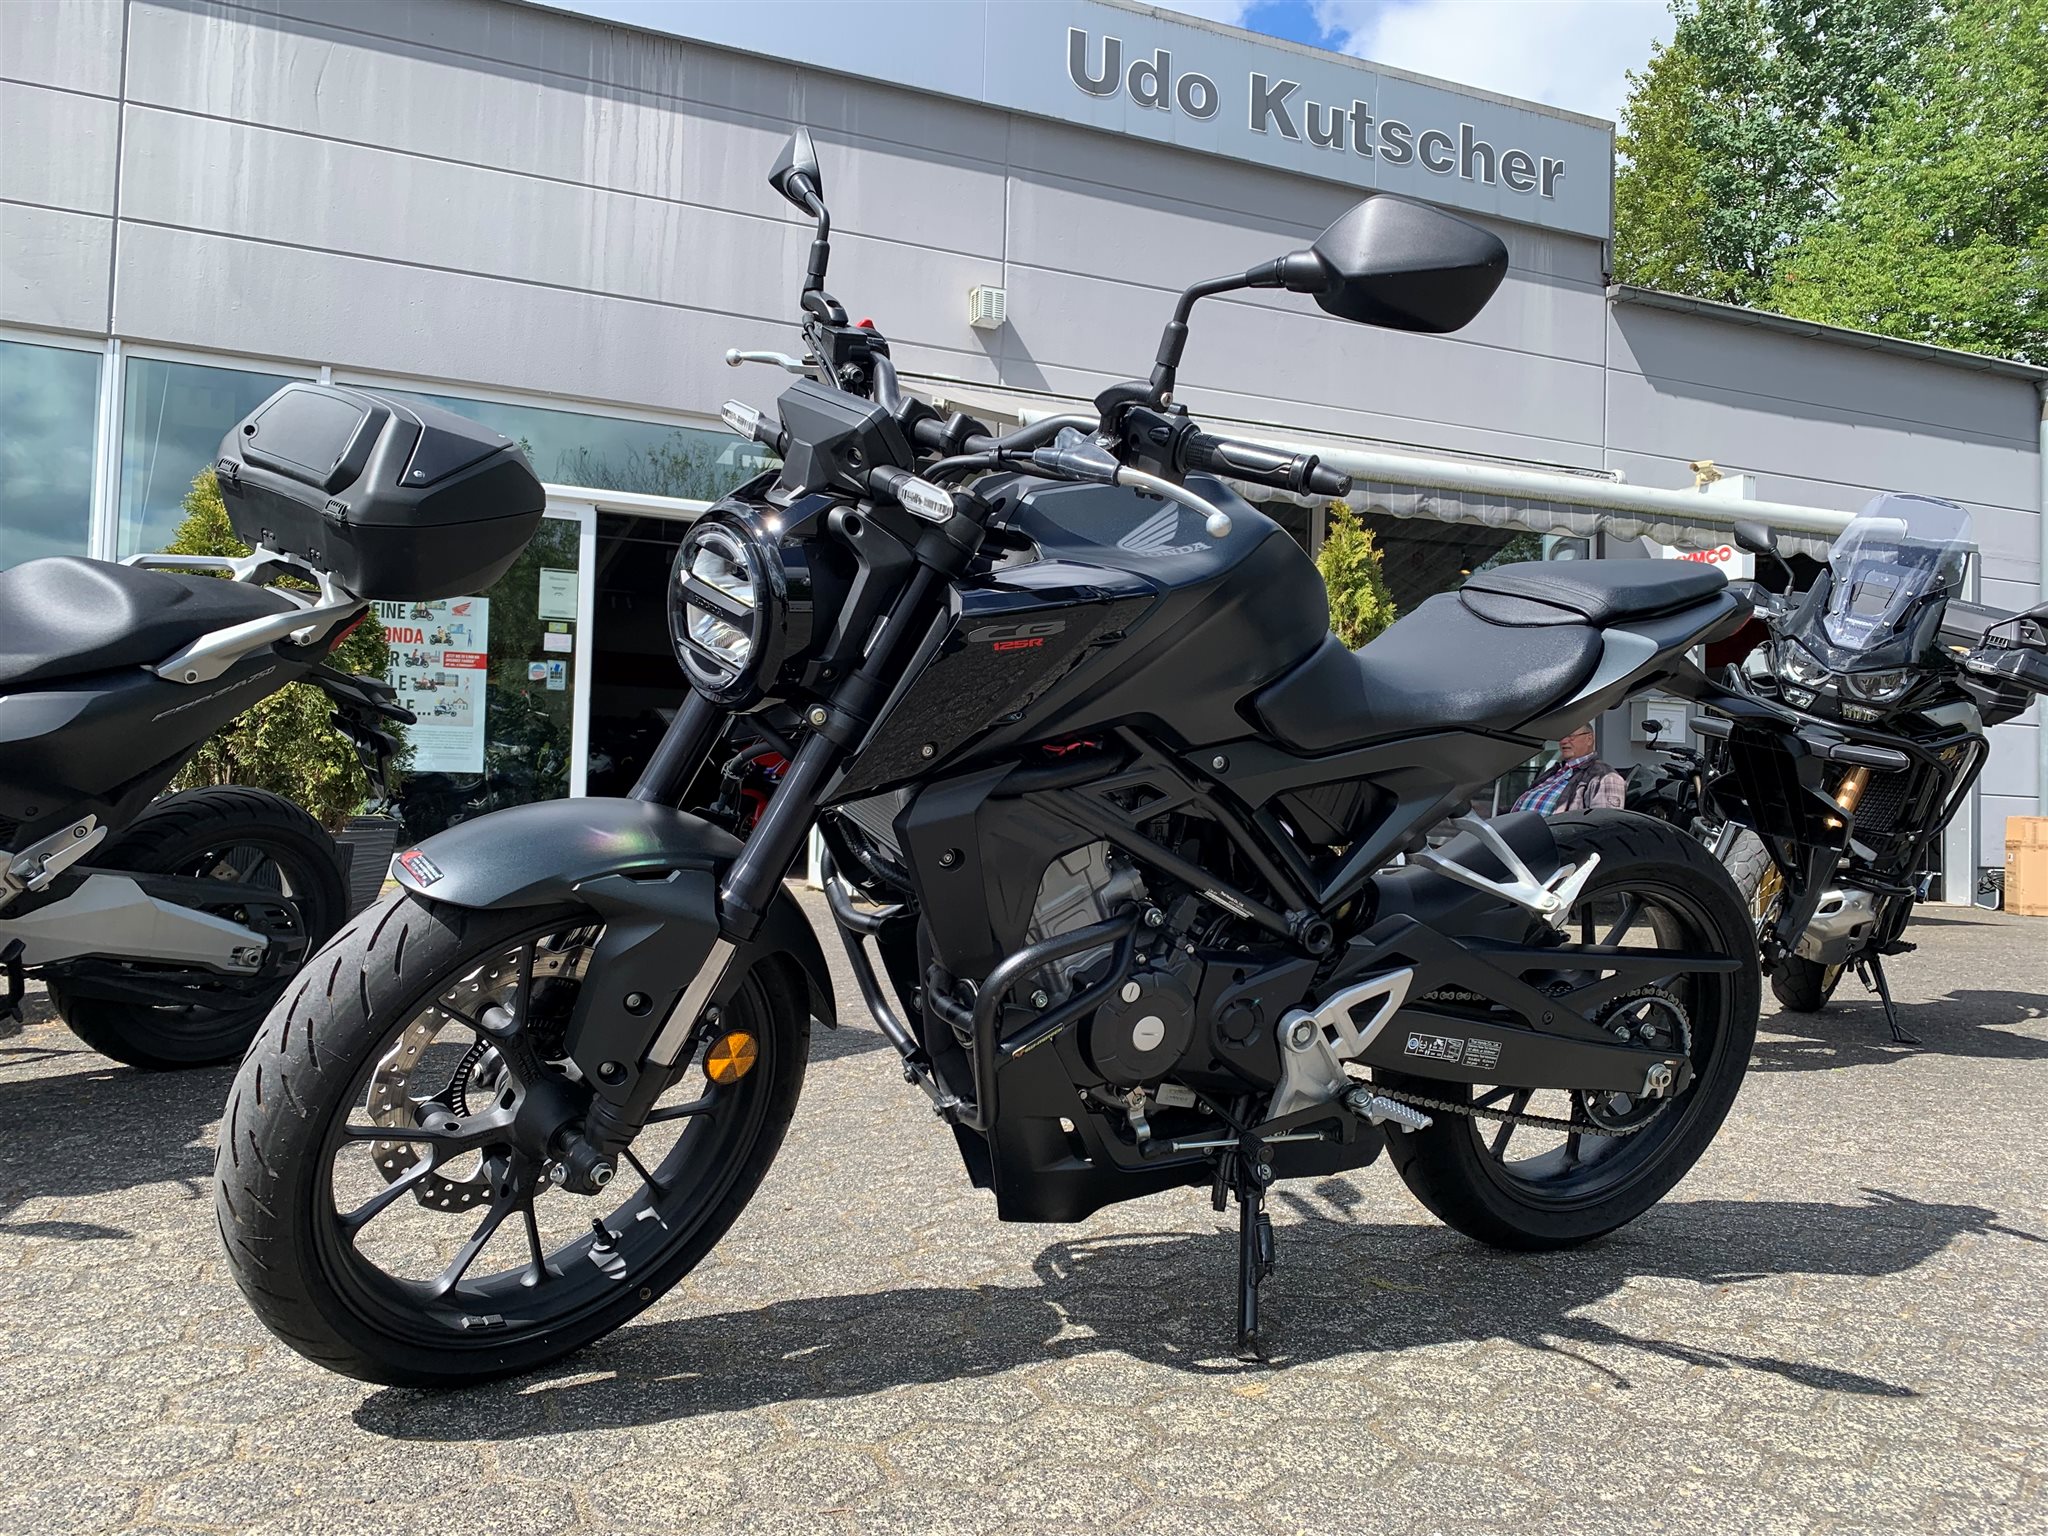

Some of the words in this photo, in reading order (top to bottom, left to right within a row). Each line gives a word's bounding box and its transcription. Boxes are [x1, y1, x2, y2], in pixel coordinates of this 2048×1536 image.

[1067, 26, 1220, 119] Udo
[1249, 71, 1565, 198] Kutscher
[968, 620, 1066, 642] CB
[993, 638, 1044, 651] 125R
